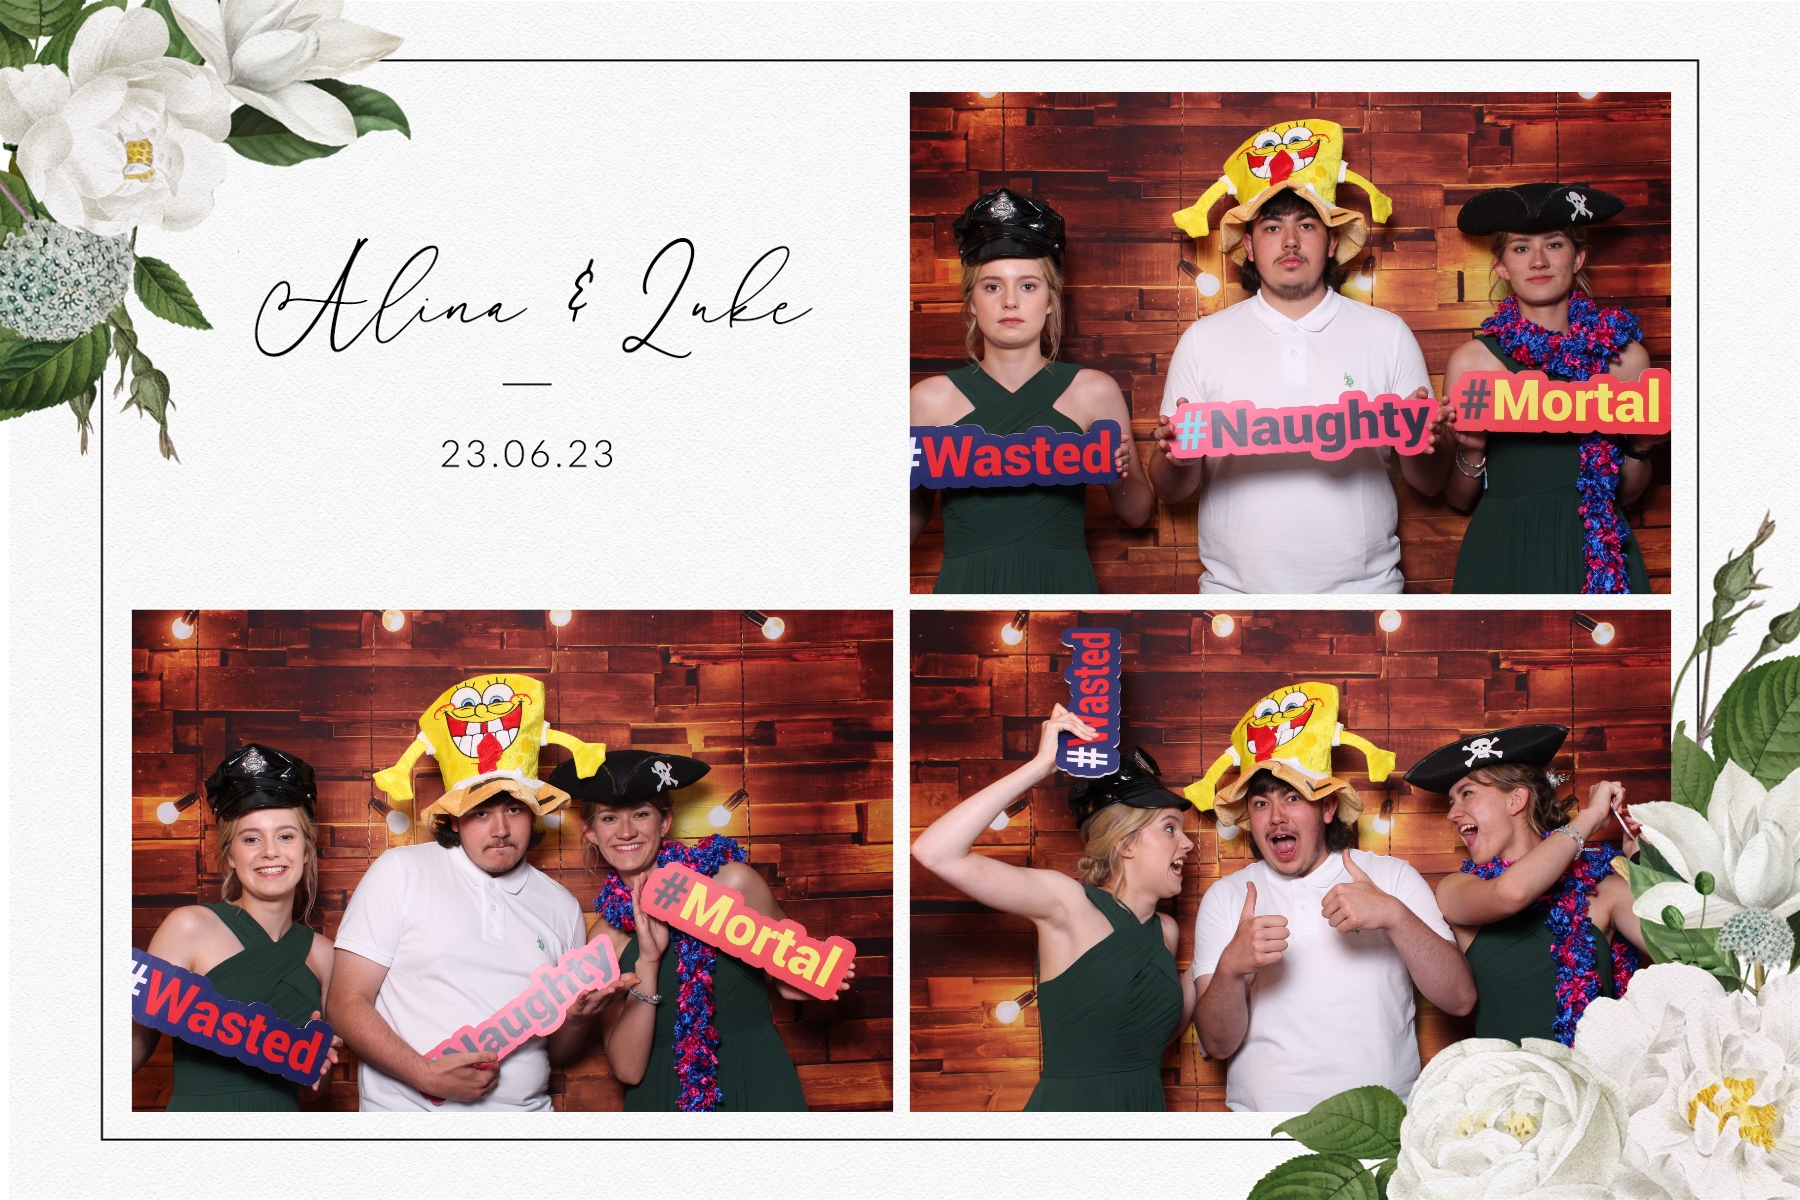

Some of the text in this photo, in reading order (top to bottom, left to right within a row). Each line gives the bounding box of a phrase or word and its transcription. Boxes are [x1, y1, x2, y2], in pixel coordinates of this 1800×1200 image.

[1175, 398, 1430, 451] #Naughty
[1459, 377, 1660, 423] #Mortal
[653, 871, 844, 988] #Mortal
